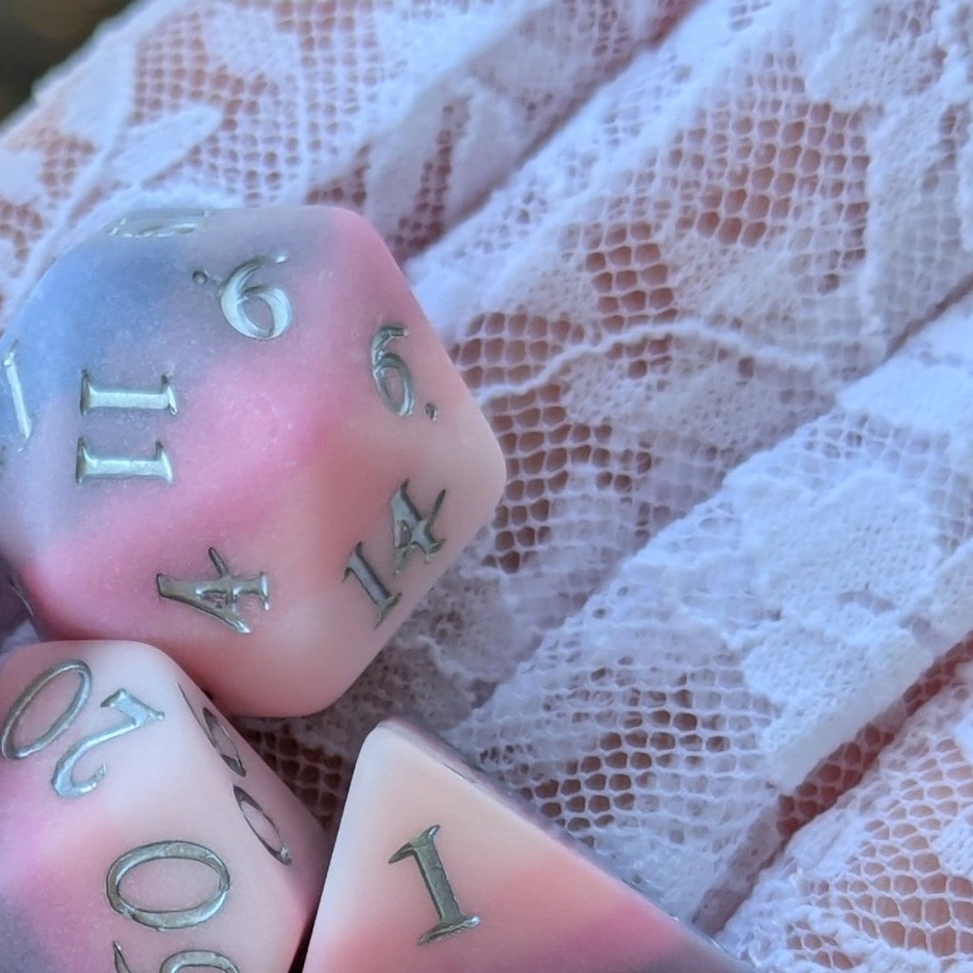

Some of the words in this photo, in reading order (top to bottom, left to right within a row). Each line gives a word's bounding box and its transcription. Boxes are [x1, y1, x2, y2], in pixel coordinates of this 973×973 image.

[75, 367, 180, 486] 11
[154, 545, 272, 635] 4
[339, 478, 448, 632] 14
[387, 823, 482, 947] 1
